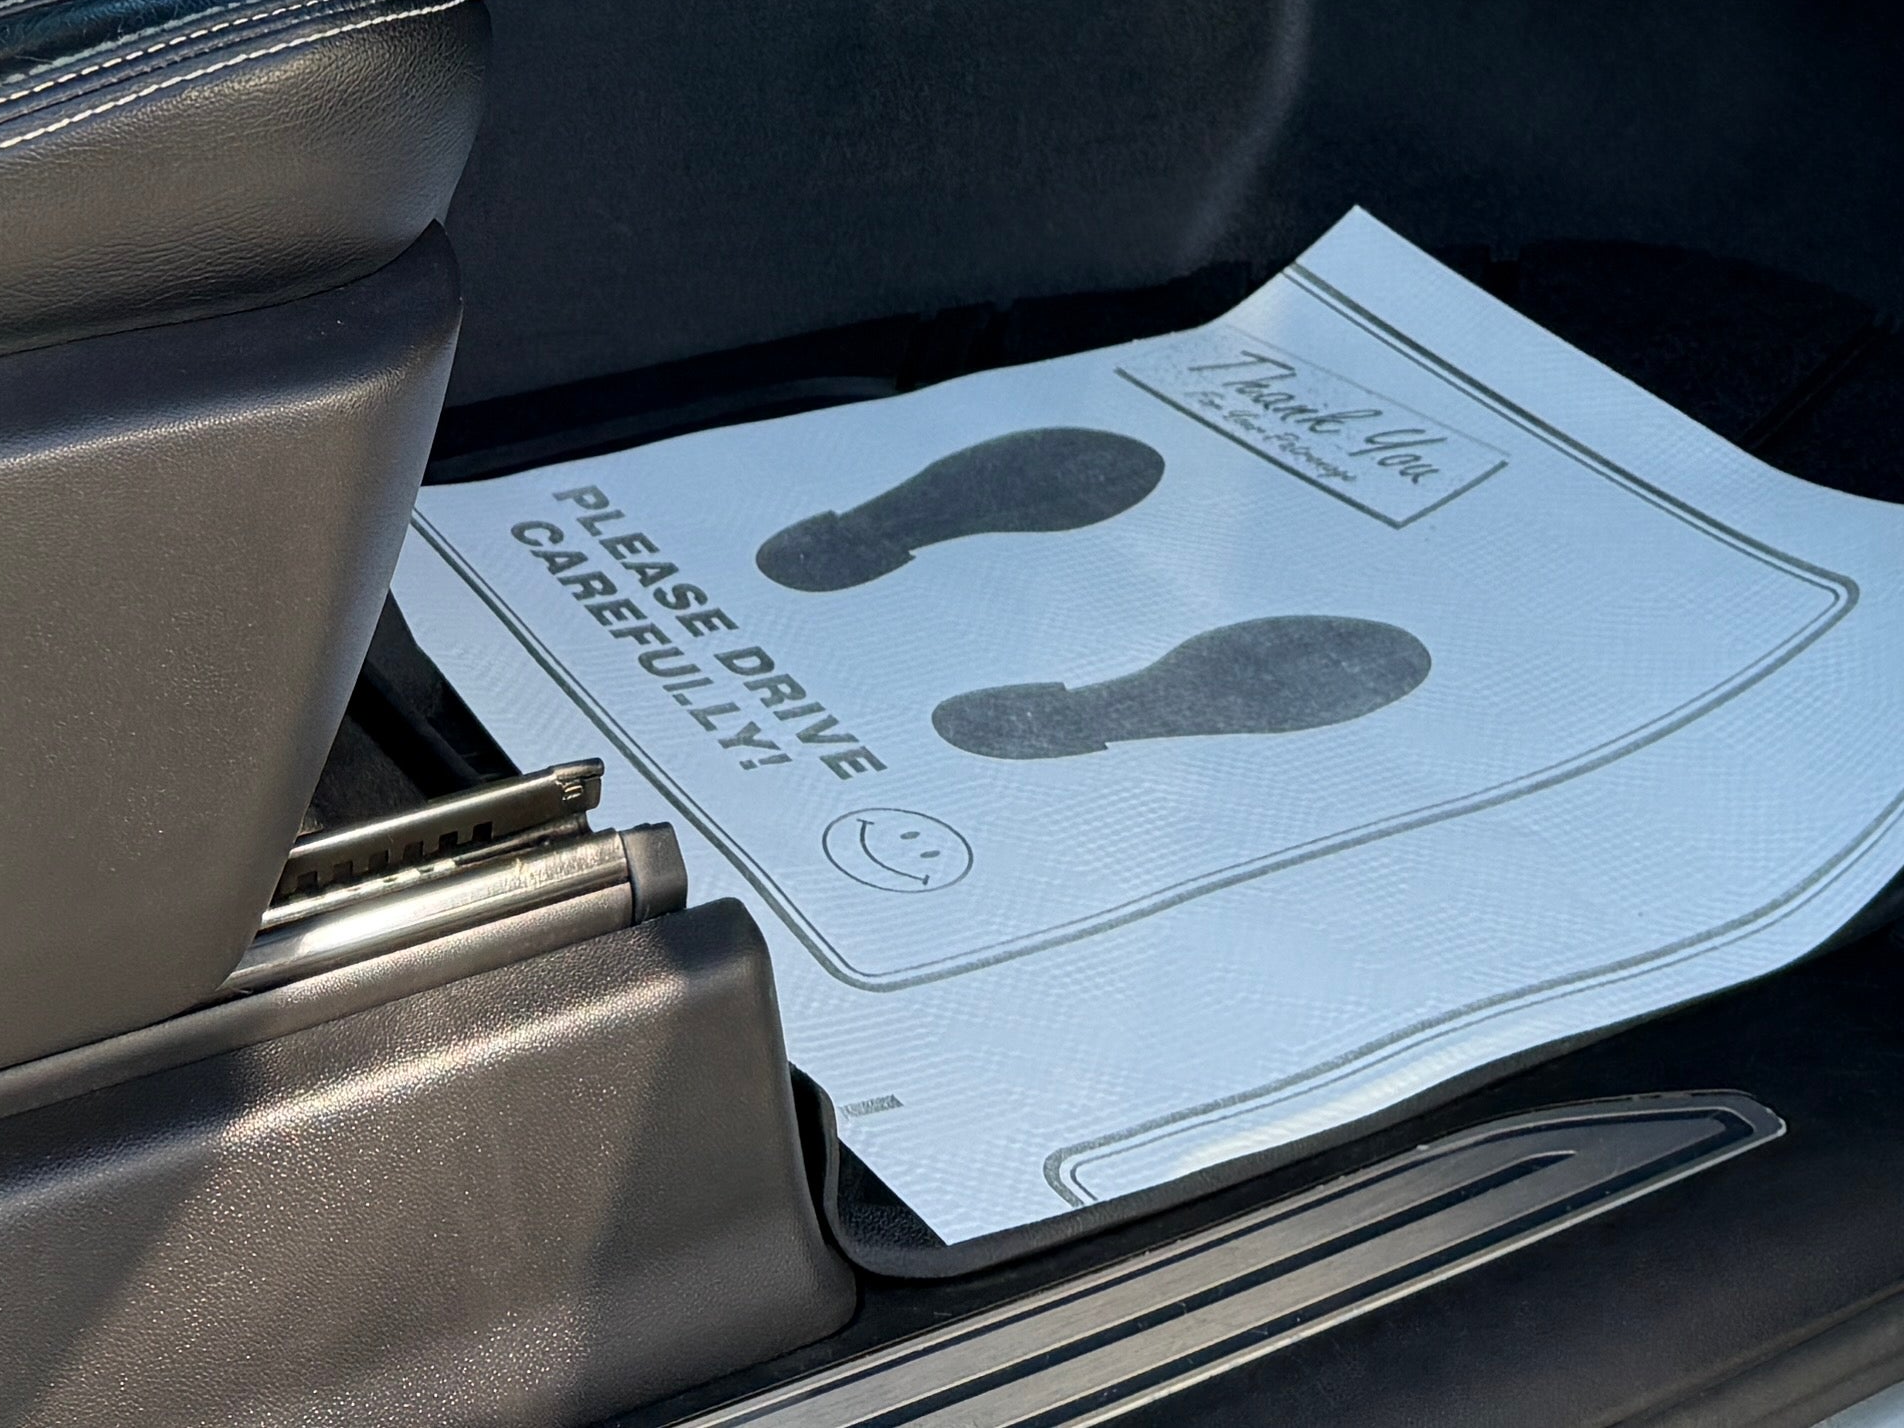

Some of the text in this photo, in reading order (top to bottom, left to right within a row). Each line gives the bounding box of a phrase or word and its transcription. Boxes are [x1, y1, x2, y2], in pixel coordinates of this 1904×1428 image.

[1188, 350, 1448, 484] Thank You
[510, 519, 794, 772] CAREFULLY!
[552, 484, 889, 781] PLEASE DRIVE
